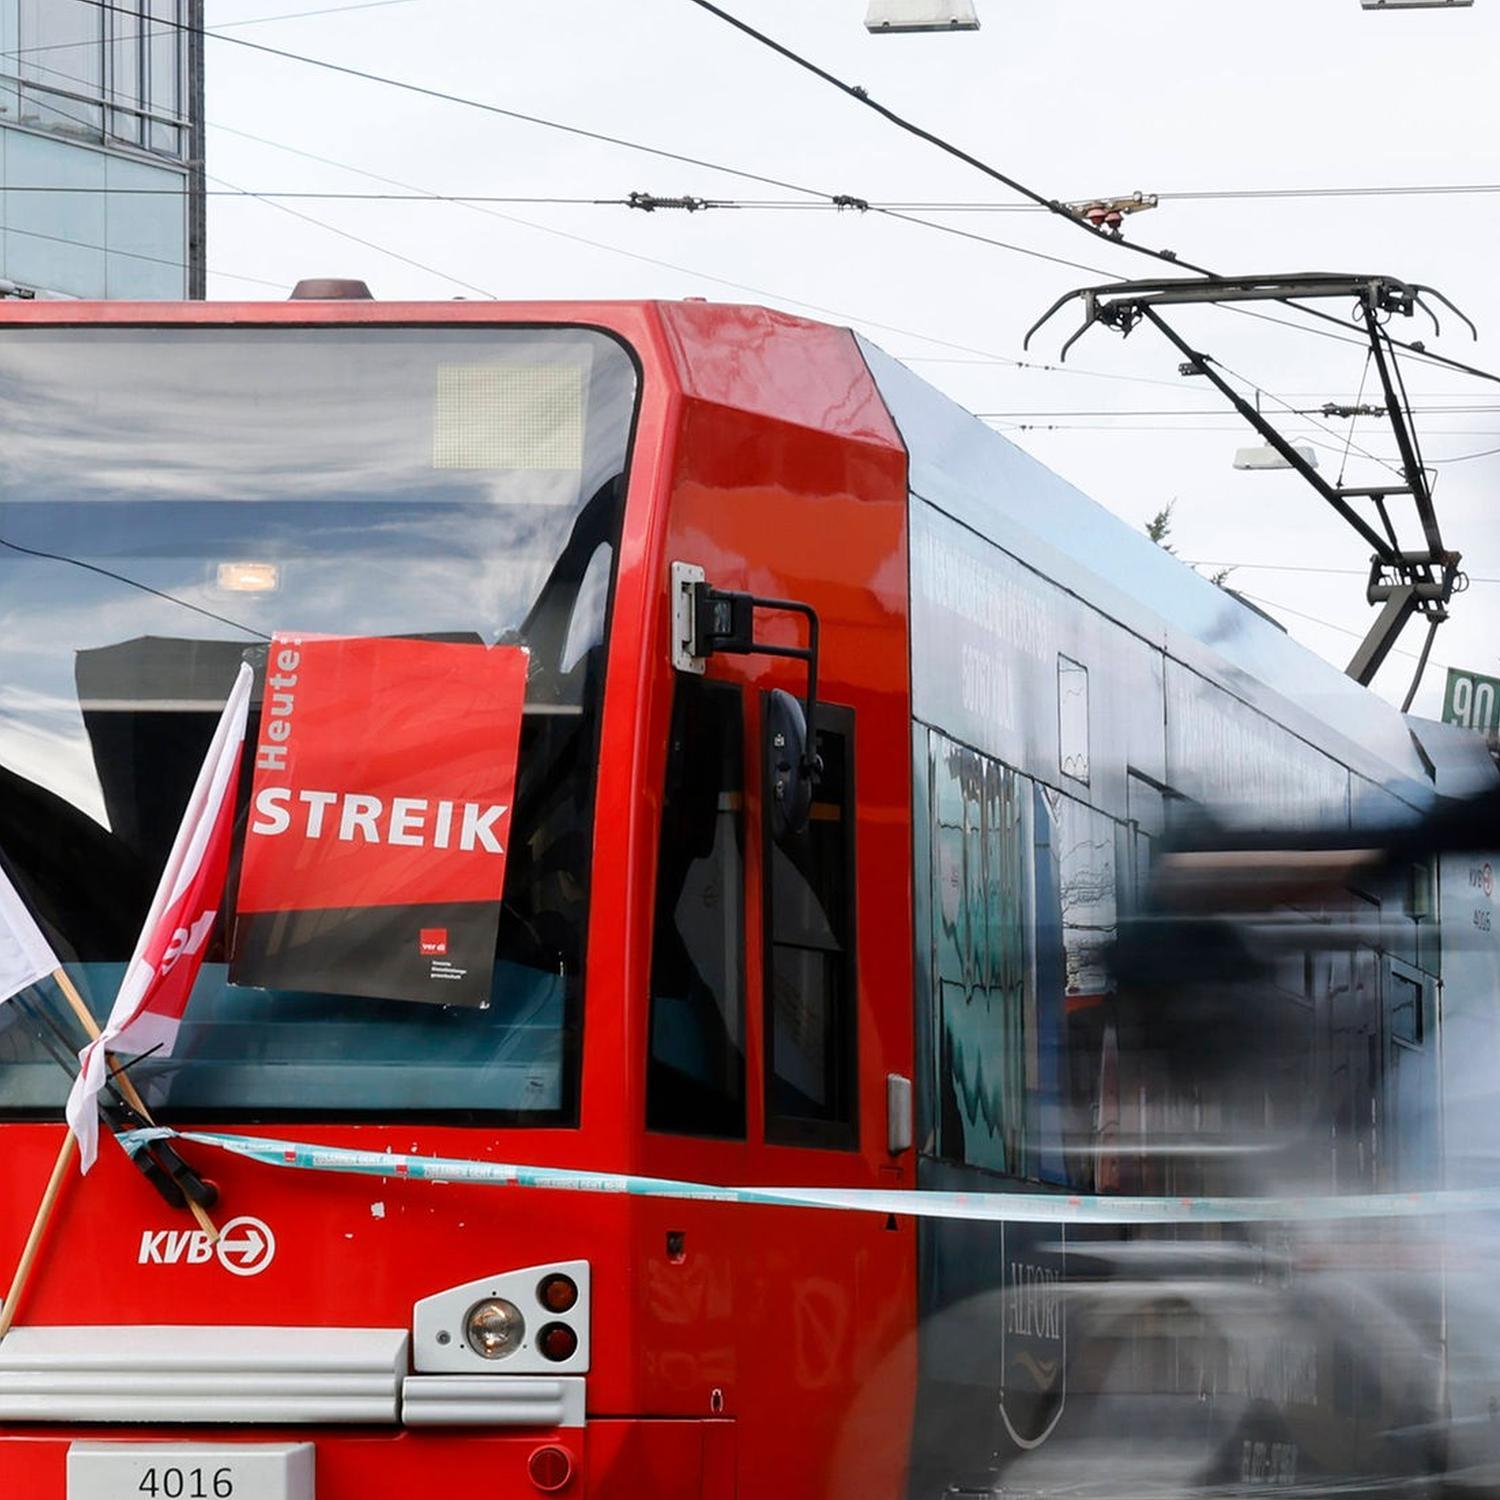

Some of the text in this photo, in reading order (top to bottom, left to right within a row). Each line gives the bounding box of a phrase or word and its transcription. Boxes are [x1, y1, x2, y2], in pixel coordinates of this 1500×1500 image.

[251, 786, 509, 854] STREIK
[138, 1230, 213, 1264] KVB
[138, 1467, 233, 1499] 4016
